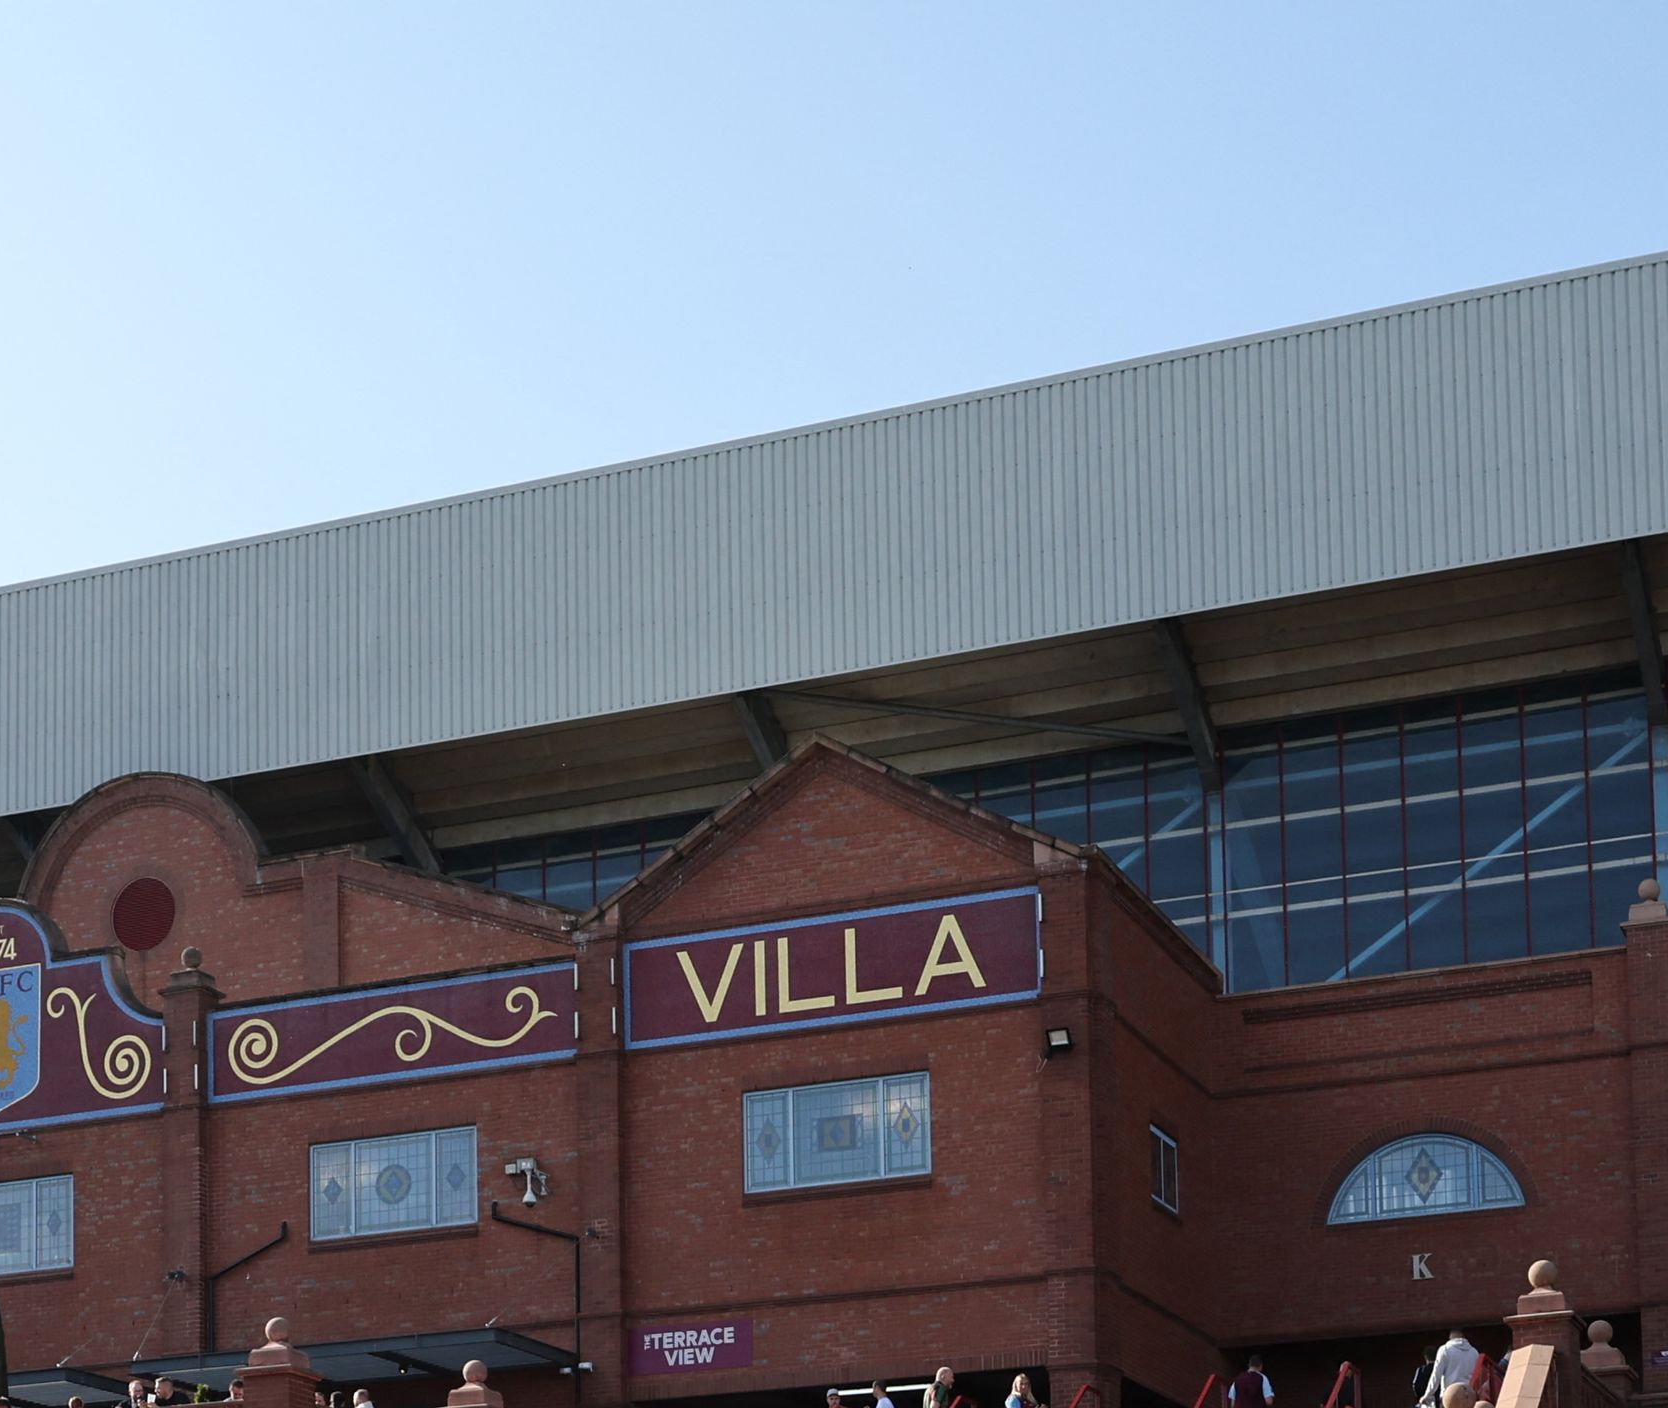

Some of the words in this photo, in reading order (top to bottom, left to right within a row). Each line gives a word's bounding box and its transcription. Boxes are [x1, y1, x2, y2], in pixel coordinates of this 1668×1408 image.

[675, 914, 987, 1023] VILLA
[1412, 1253, 1435, 1280] K
[651, 1326, 735, 1350] TERRACE
[664, 1346, 715, 1367] VIEW
